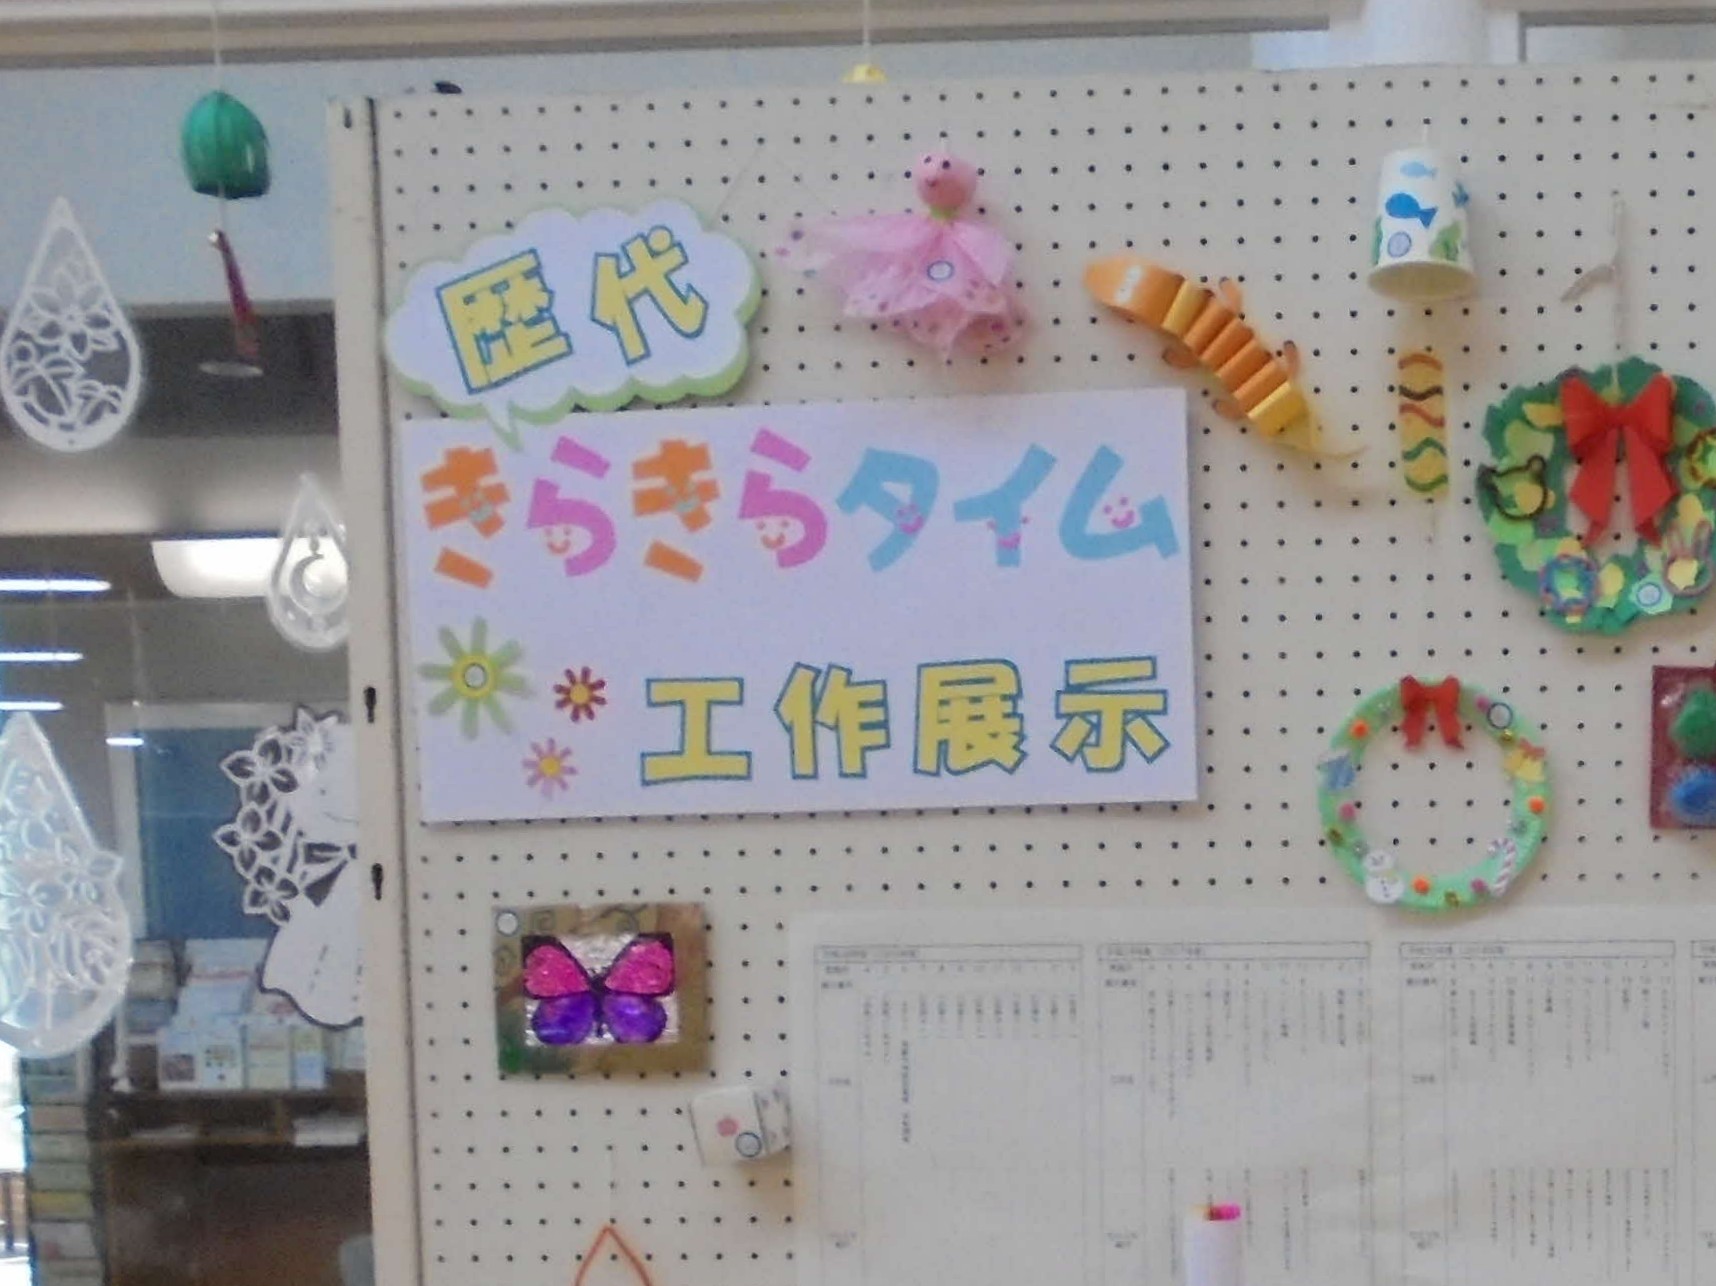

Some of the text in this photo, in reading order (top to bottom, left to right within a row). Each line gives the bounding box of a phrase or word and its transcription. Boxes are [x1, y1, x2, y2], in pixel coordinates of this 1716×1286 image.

[435, 225, 709, 395] 歴代
[419, 428, 1182, 589] きらきらタイム
[640, 656, 1171, 787] 工作展示
